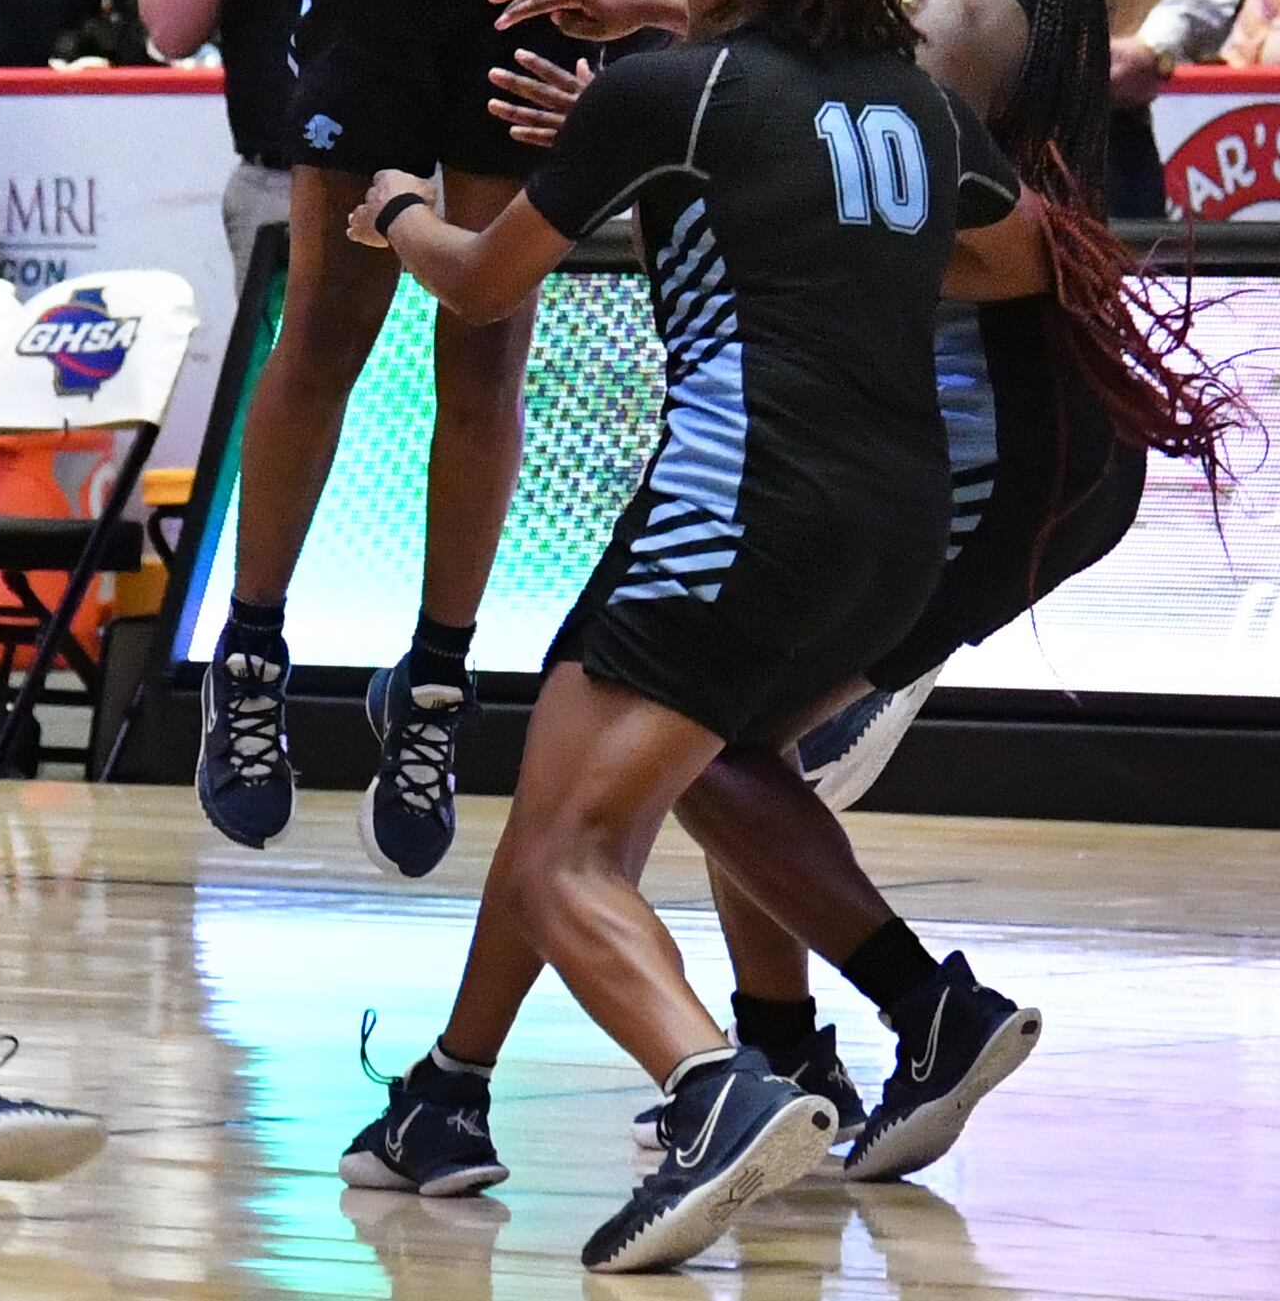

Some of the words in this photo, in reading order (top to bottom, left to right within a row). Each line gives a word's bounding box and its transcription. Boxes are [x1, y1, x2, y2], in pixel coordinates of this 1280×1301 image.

[814, 101, 929, 235] 10
[6, 176, 97, 236] MRI
[20, 317, 141, 355] GHSA
